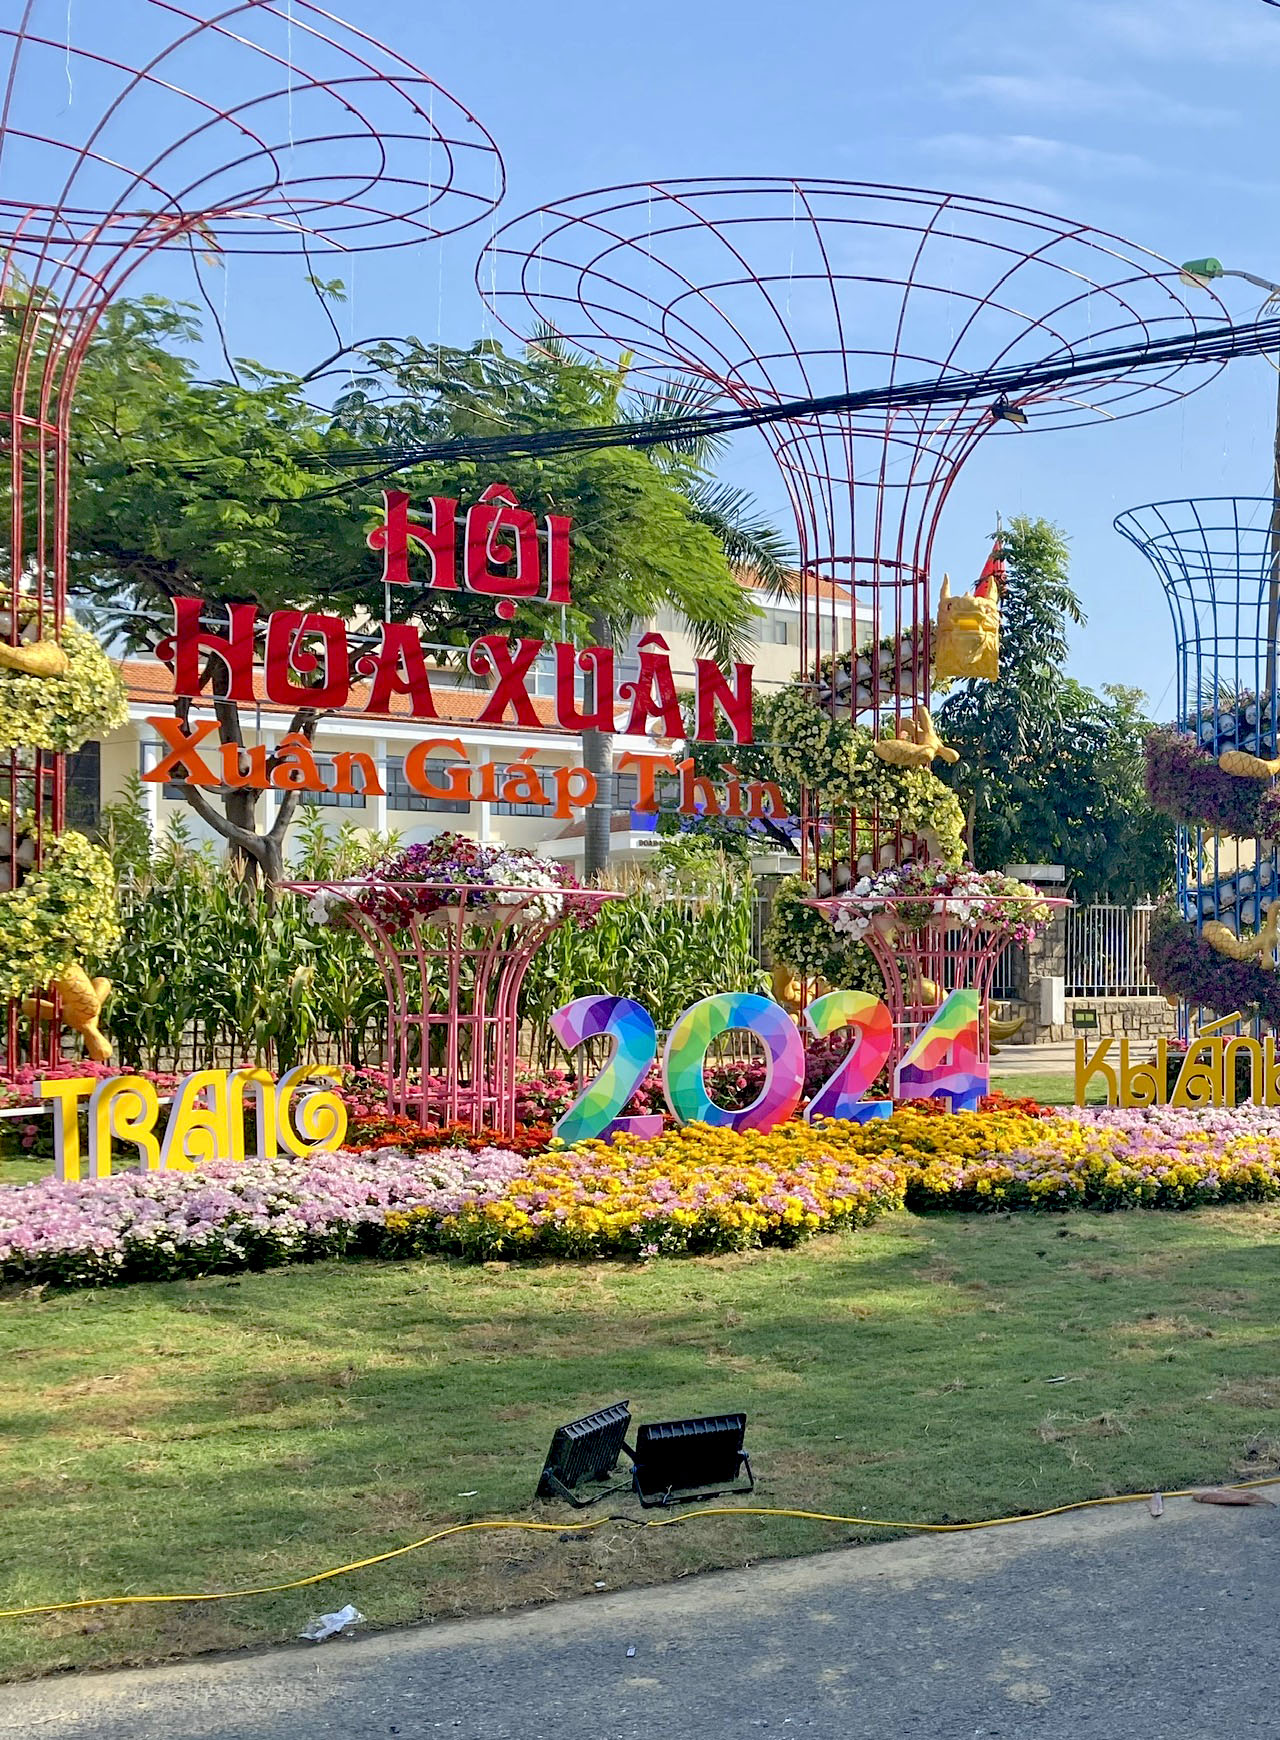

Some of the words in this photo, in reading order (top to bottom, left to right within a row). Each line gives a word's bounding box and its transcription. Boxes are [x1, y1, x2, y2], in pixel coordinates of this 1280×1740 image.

[367, 482, 574, 620] HỘI
[154, 596, 441, 718] HOA
[468, 631, 755, 745] XUÂN
[140, 715, 387, 796] Xuân
[403, 737, 599, 819] Giáp
[616, 751, 790, 819] Thìn
[33, 1064, 349, 1181] TRANG
[549, 988, 991, 1146] 2024
